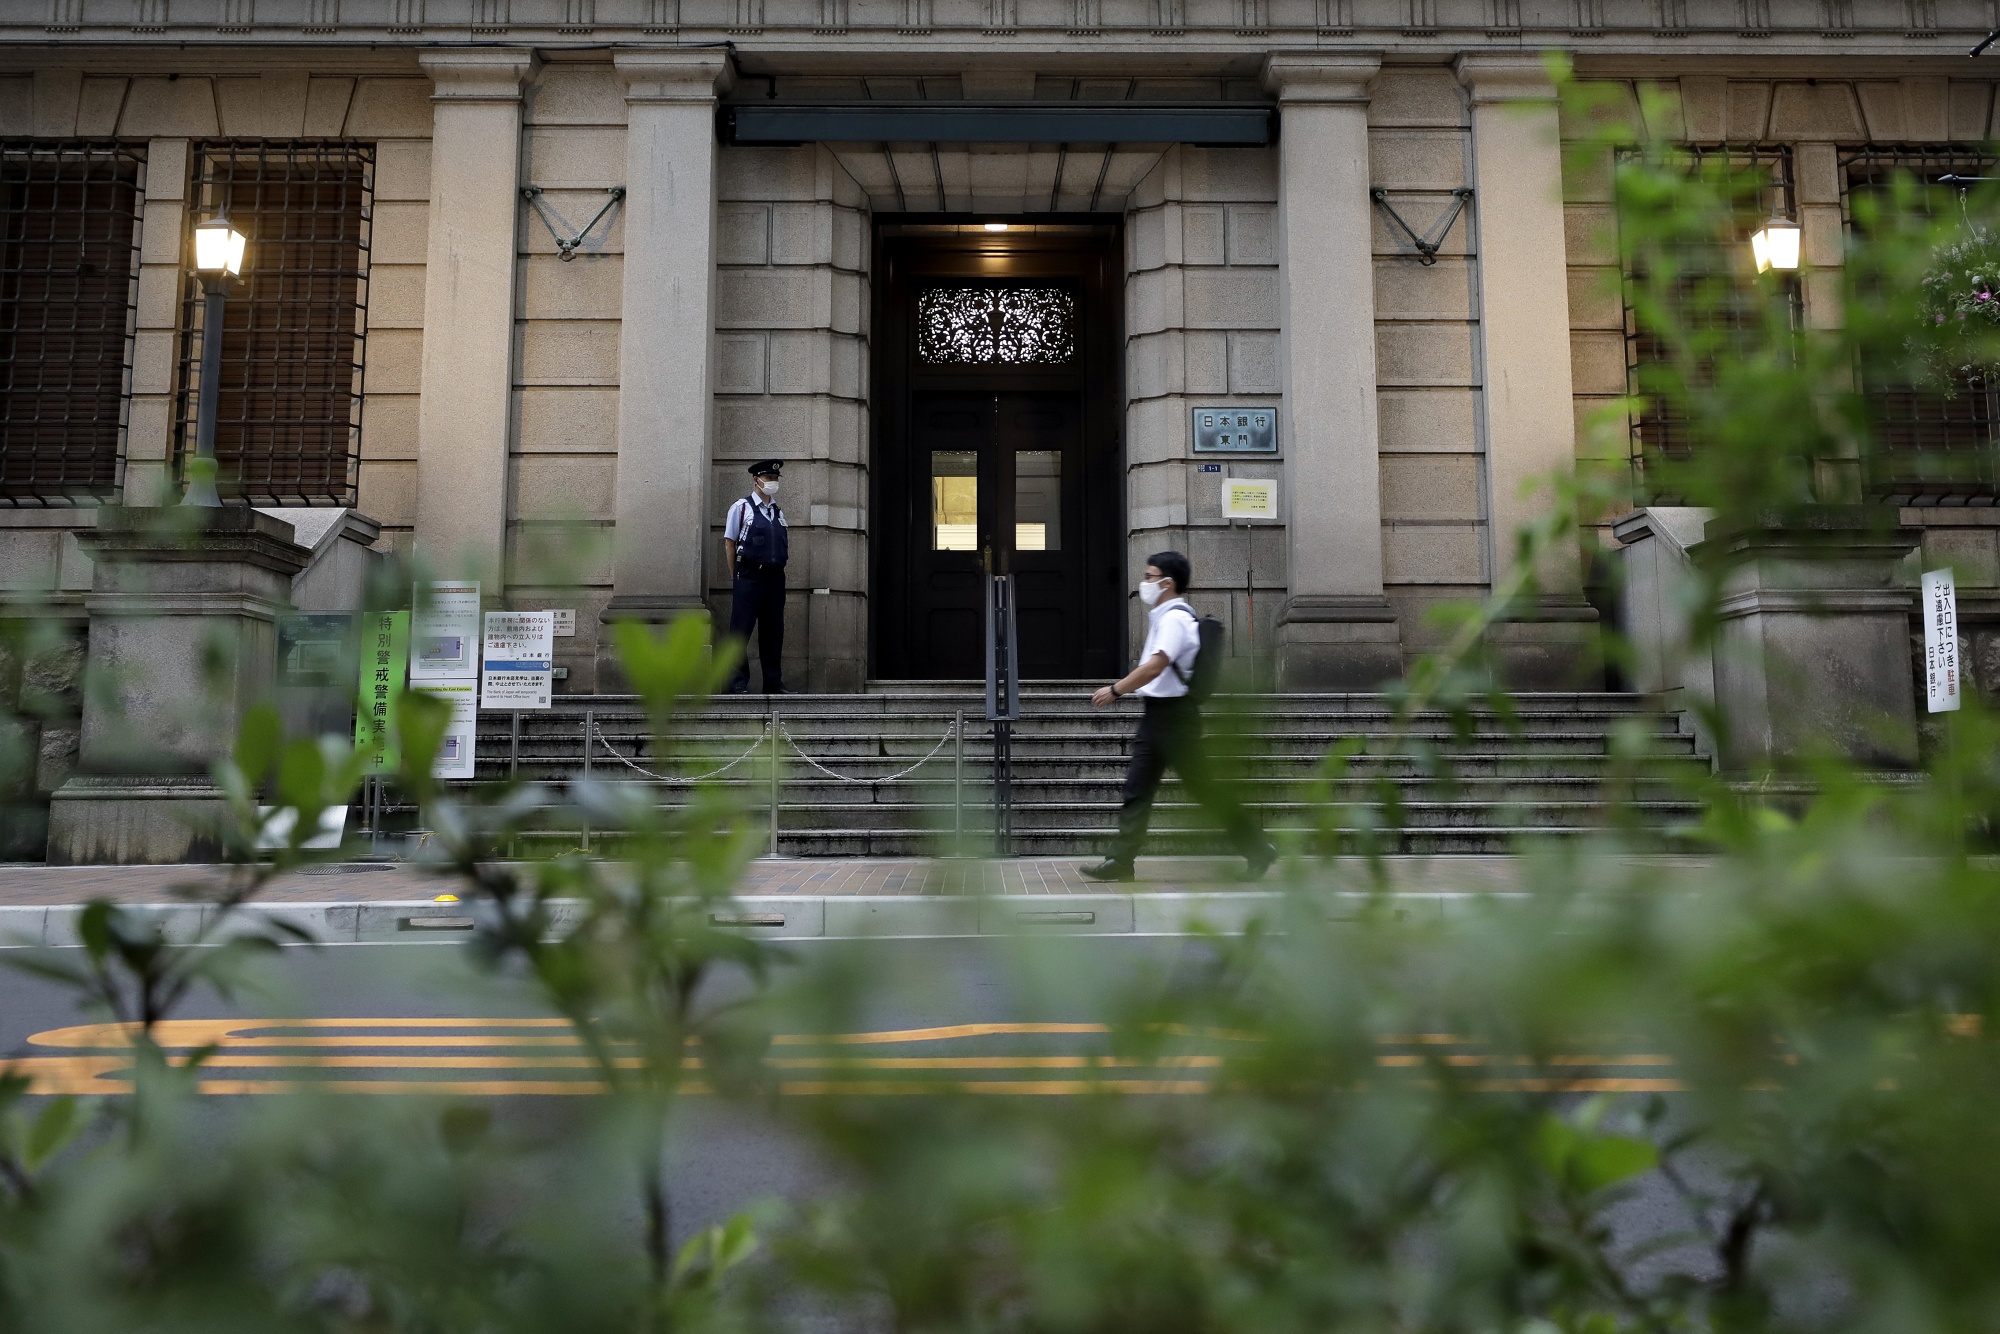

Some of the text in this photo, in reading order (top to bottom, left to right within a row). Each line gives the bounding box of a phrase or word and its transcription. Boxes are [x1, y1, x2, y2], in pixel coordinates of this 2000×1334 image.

[1204, 415, 1266, 427] 日本銀行
[1220, 434, 1248, 446] 東門
[1934, 584, 1946, 668] ご遠慮下さい
[1942, 583, 1956, 696] 出入口につき駐車
[1928, 646, 1936, 698] 日本銀行
